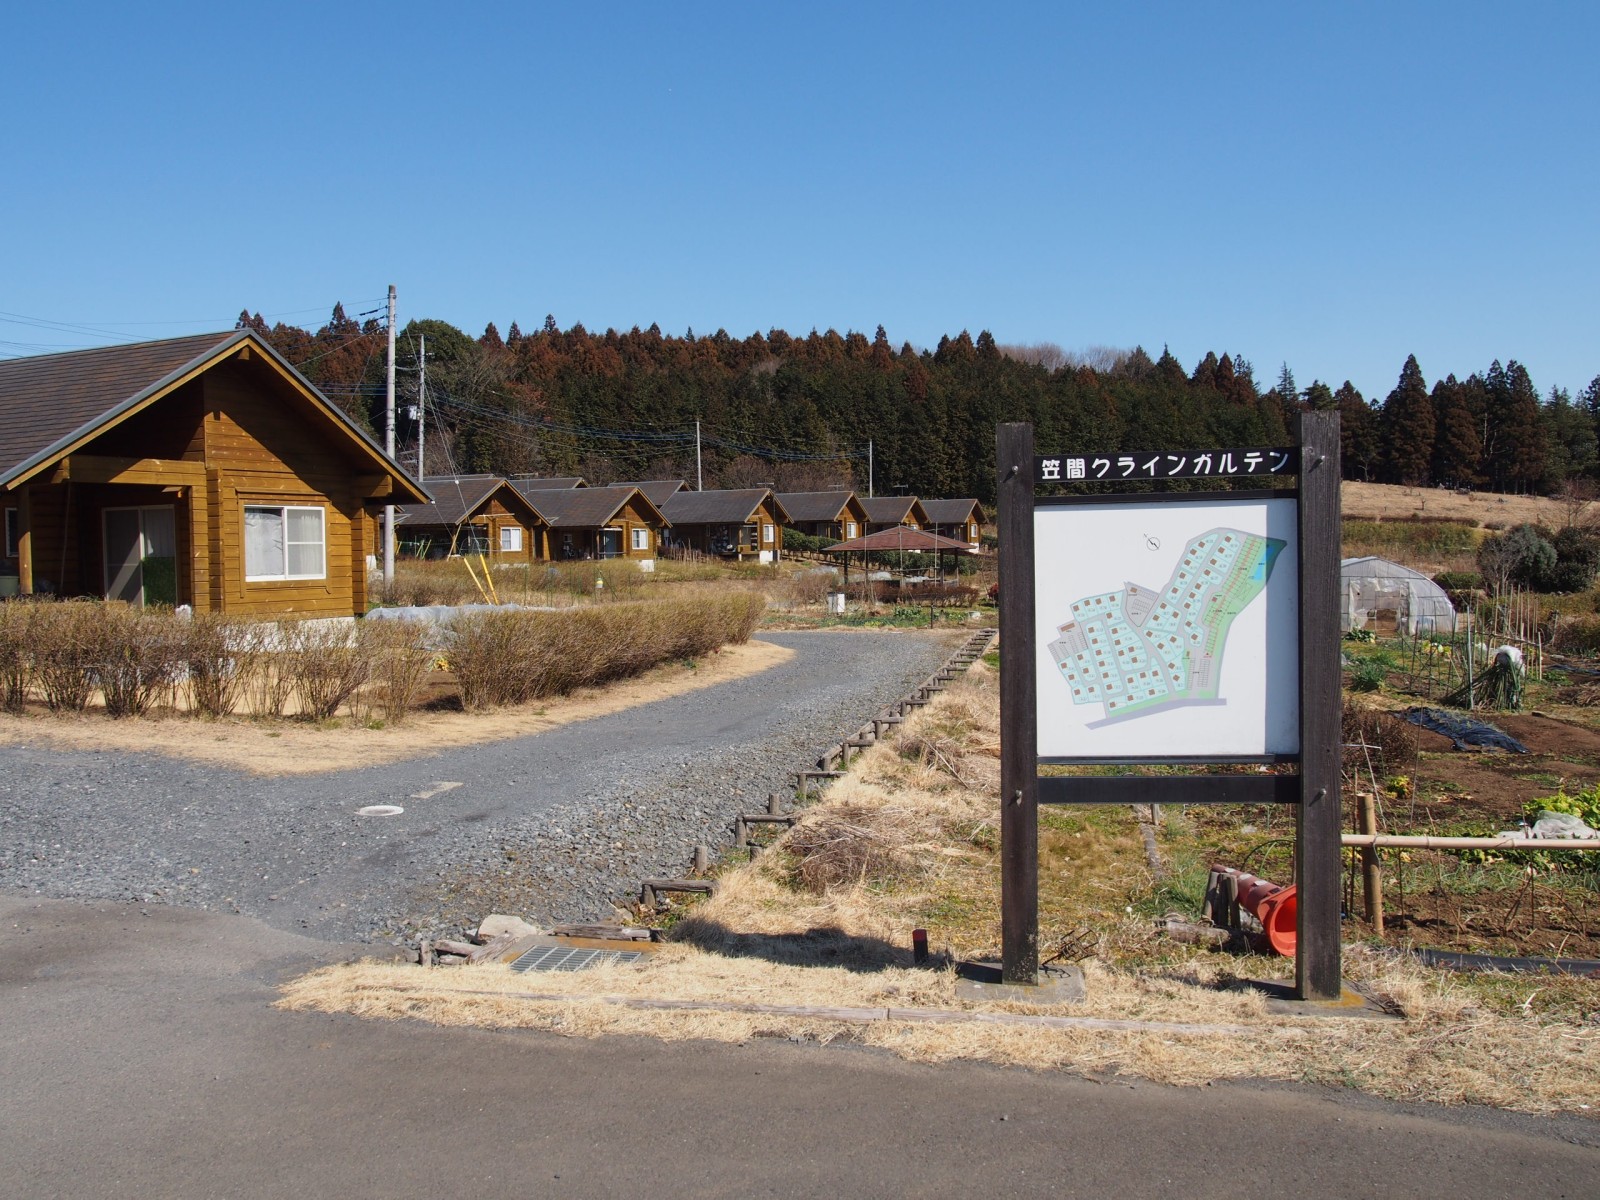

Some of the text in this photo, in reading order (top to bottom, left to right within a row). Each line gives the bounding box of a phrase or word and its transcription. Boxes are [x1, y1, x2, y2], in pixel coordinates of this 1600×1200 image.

[1041, 451, 1289, 480] 笠間クラインガルテン
